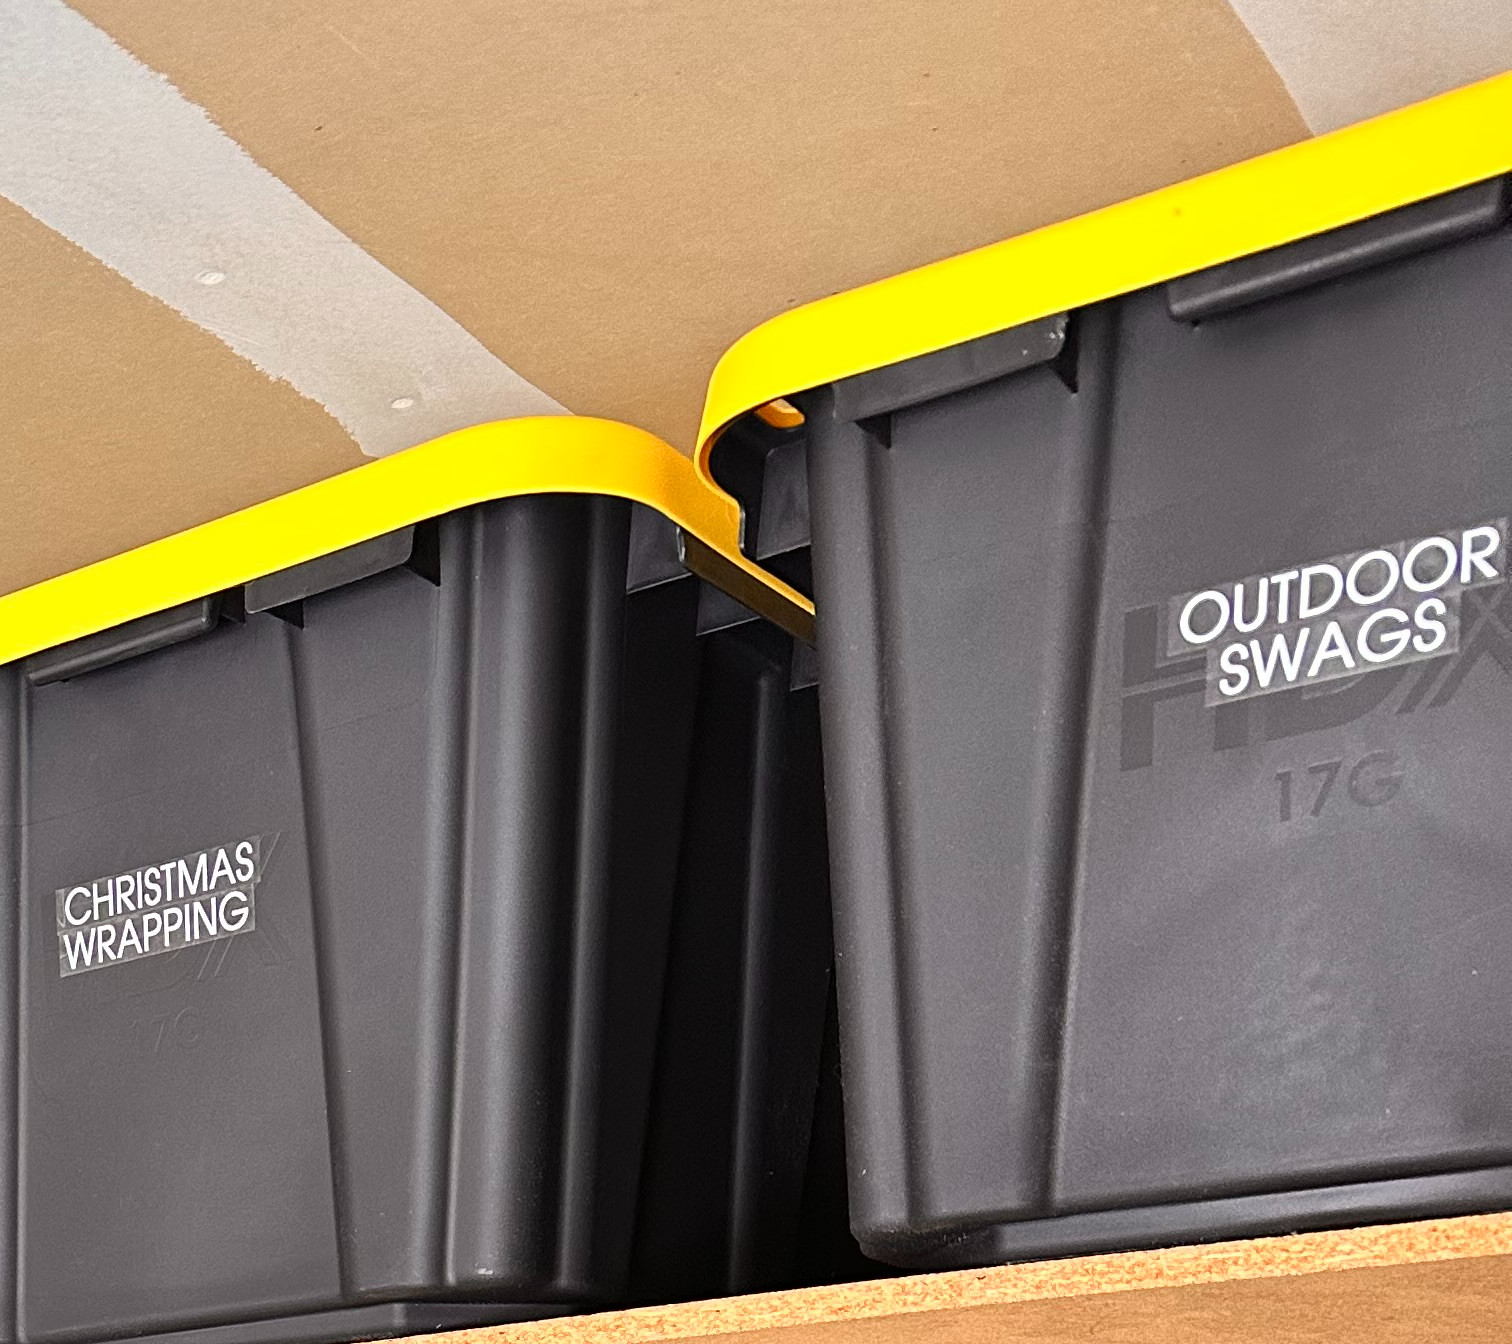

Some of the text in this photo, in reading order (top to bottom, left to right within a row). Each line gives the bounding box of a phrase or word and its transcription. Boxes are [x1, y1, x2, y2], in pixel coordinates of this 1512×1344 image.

[1179, 525, 1501, 645] OUTDOOR
[1218, 597, 1447, 696] SWAGS
[1275, 751, 1403, 823] 17G
[64, 841, 255, 926] CHRISTMAS
[62, 890, 249, 970] WRAPPING
